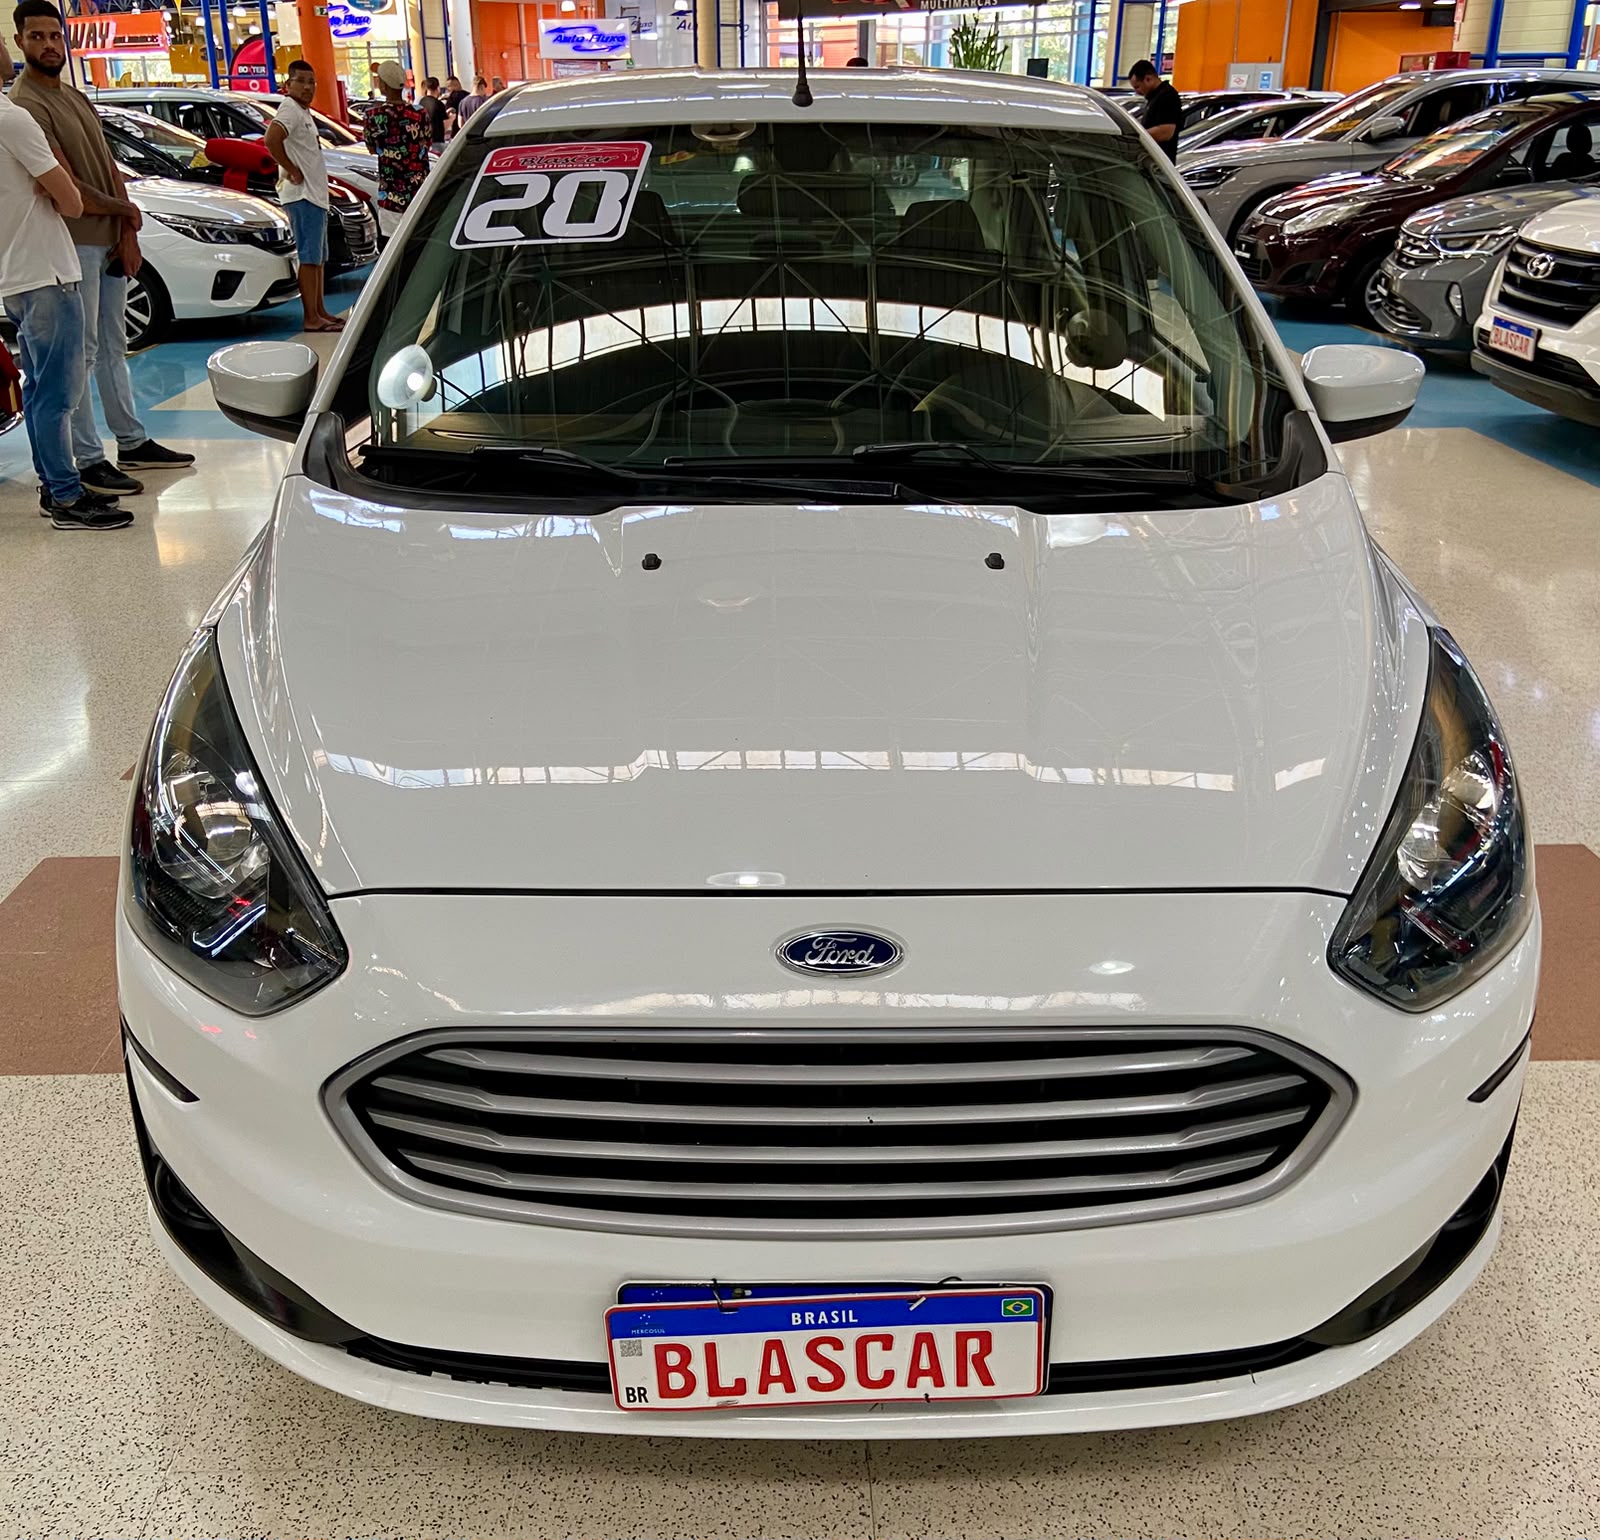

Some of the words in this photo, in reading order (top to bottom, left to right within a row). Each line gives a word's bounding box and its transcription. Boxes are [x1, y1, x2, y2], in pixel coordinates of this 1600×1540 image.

[920, 0, 998, 10] MULTIMARCAS
[553, 34, 585, 43] Auto
[589, 33, 626, 43] Fluxo
[464, 170, 630, 242] 20
[804, 936, 875, 965] Ford
[791, 1309, 859, 1326] BRASIL
[653, 1330, 996, 1399] BLASCAR
[625, 1386, 649, 1403] BR
